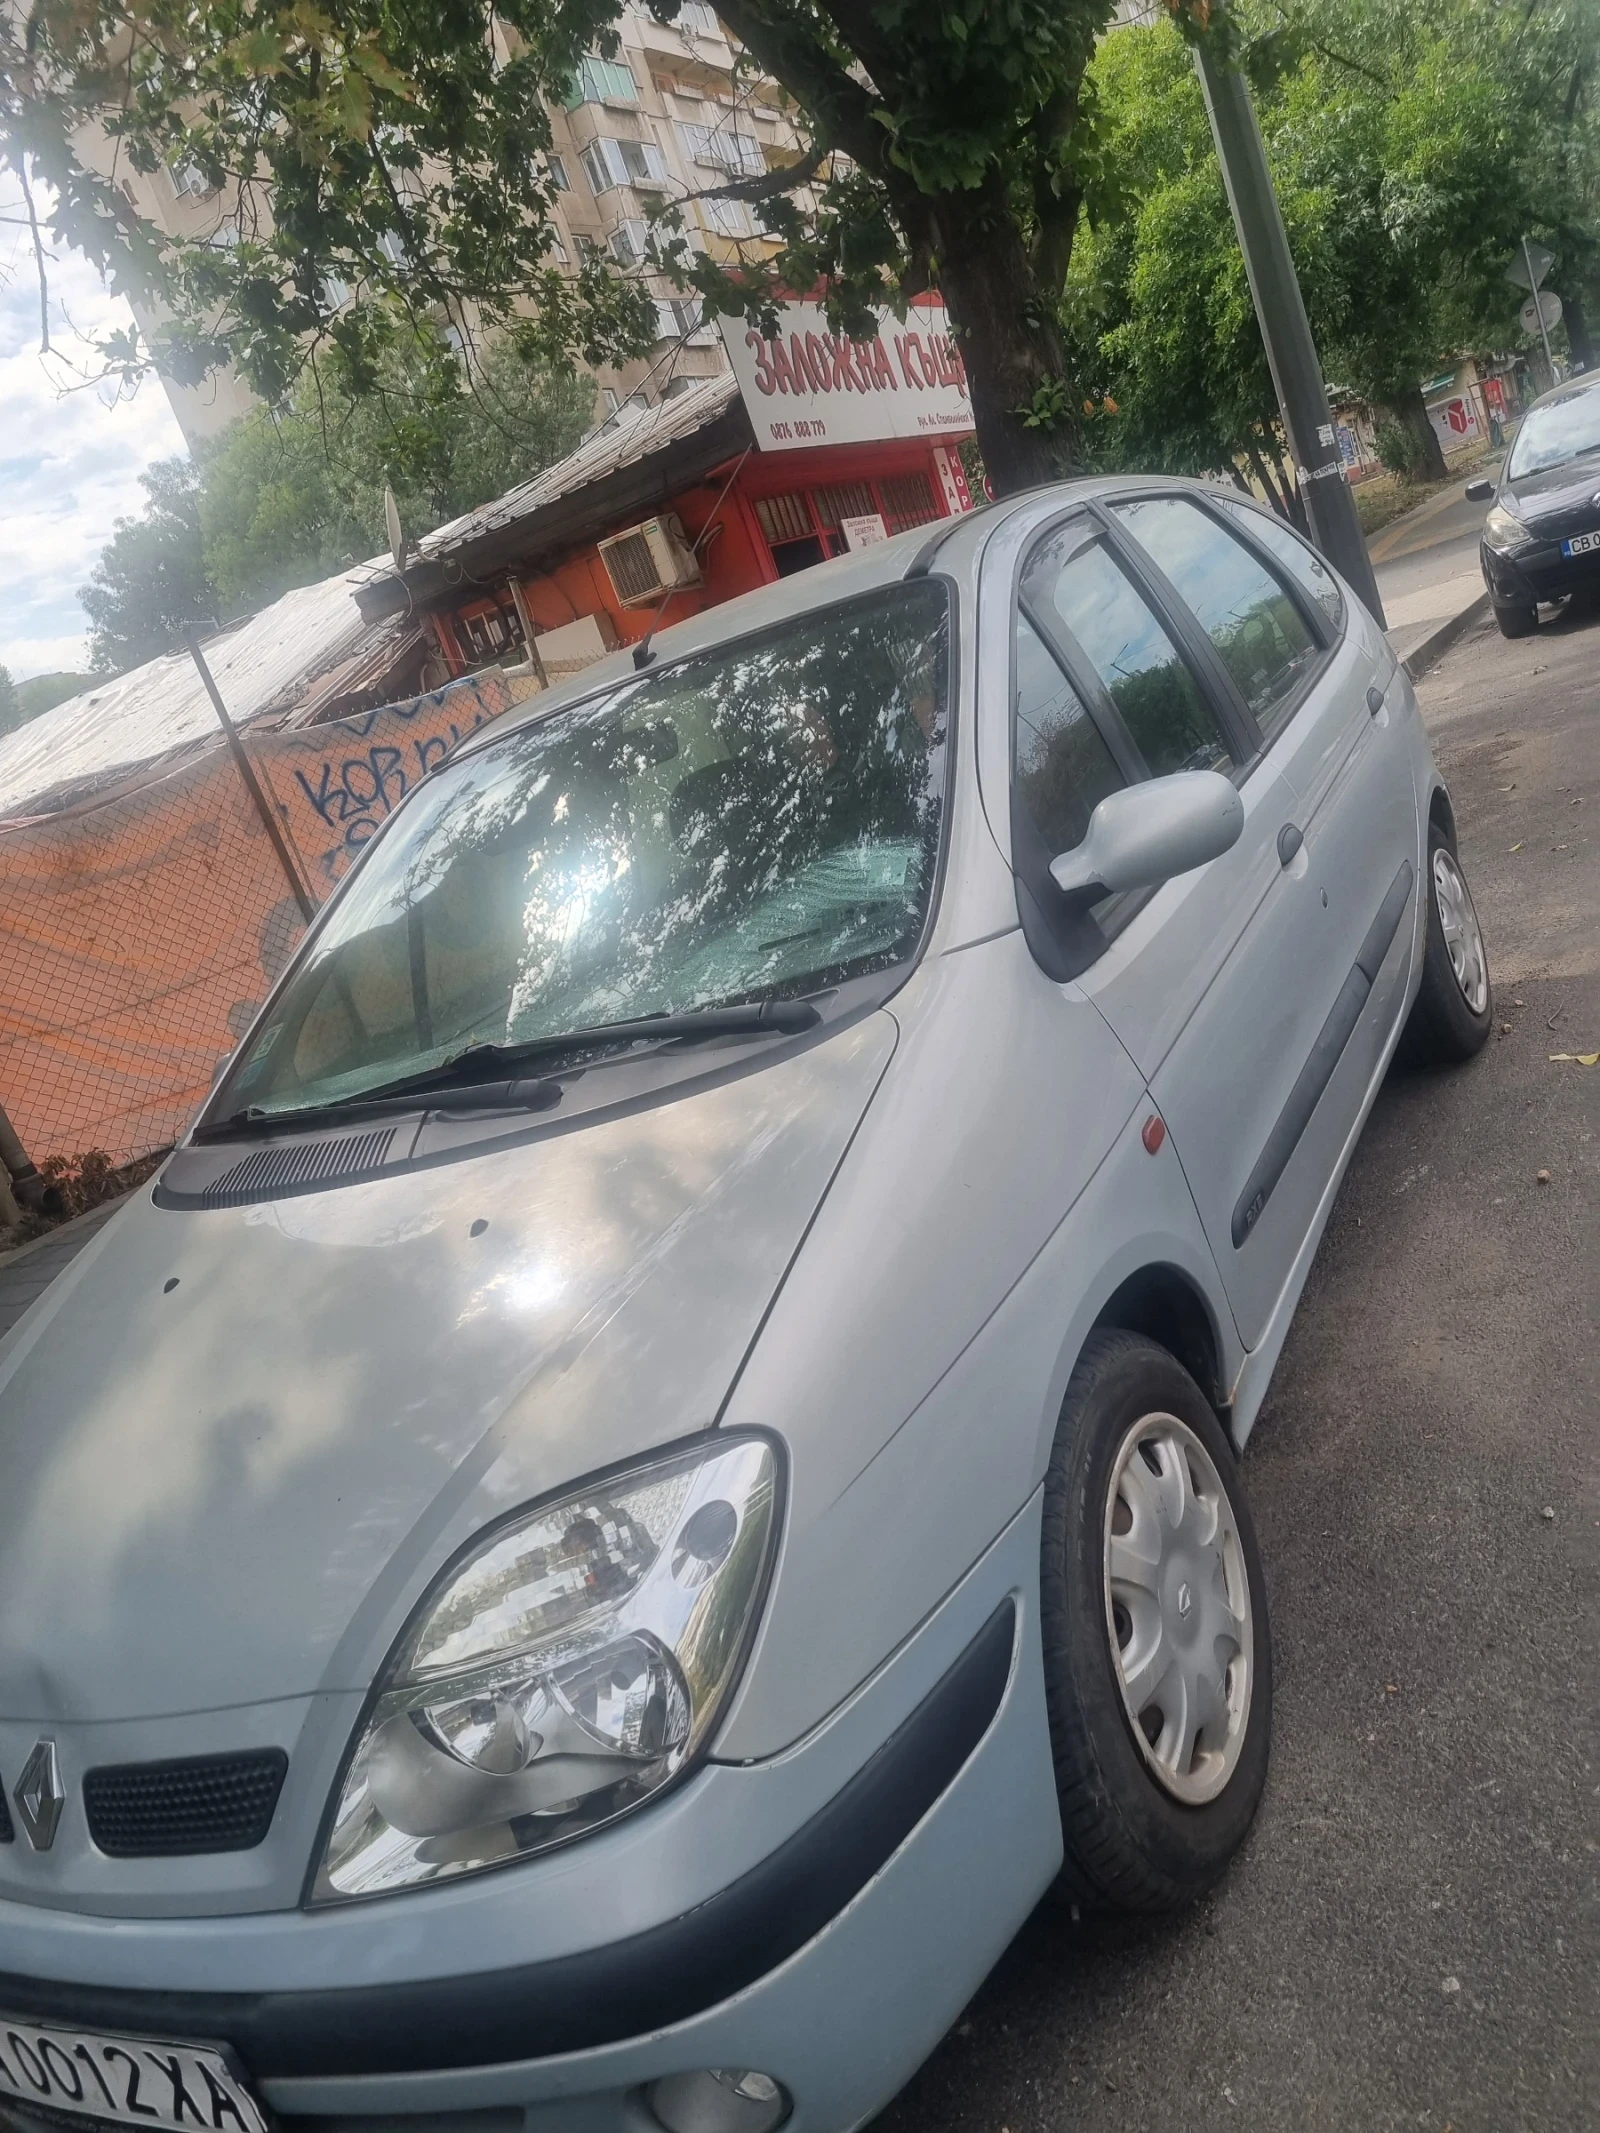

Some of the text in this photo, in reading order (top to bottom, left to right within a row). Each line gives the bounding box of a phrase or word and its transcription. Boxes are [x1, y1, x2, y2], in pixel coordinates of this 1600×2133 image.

[745, 330, 897, 396] ЗАЛОЖНА
[770, 419, 826, 440] 0876 888 779
[1571, 536, 1591, 553] CB
